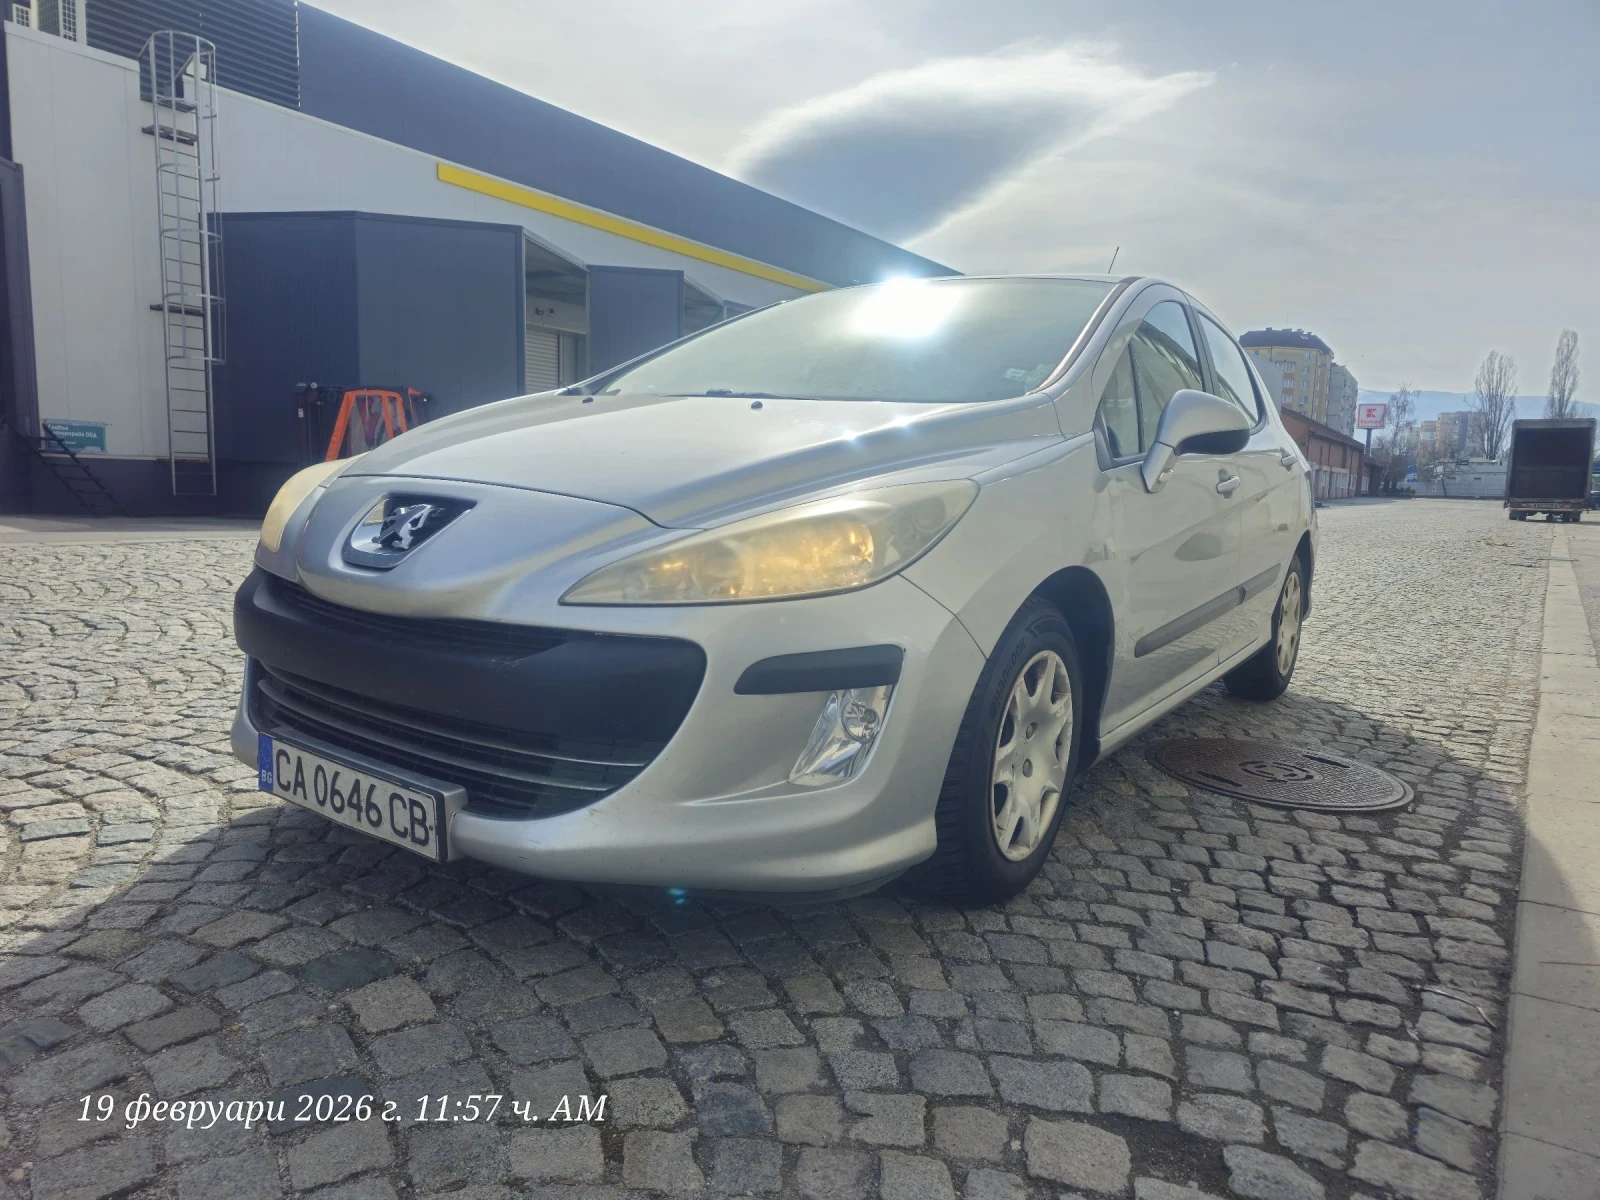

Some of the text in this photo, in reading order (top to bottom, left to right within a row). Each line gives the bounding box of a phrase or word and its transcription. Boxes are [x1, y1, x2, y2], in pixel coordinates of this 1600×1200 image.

[261, 769, 273, 784] BG
[275, 748, 430, 847] CA 0646 CB
